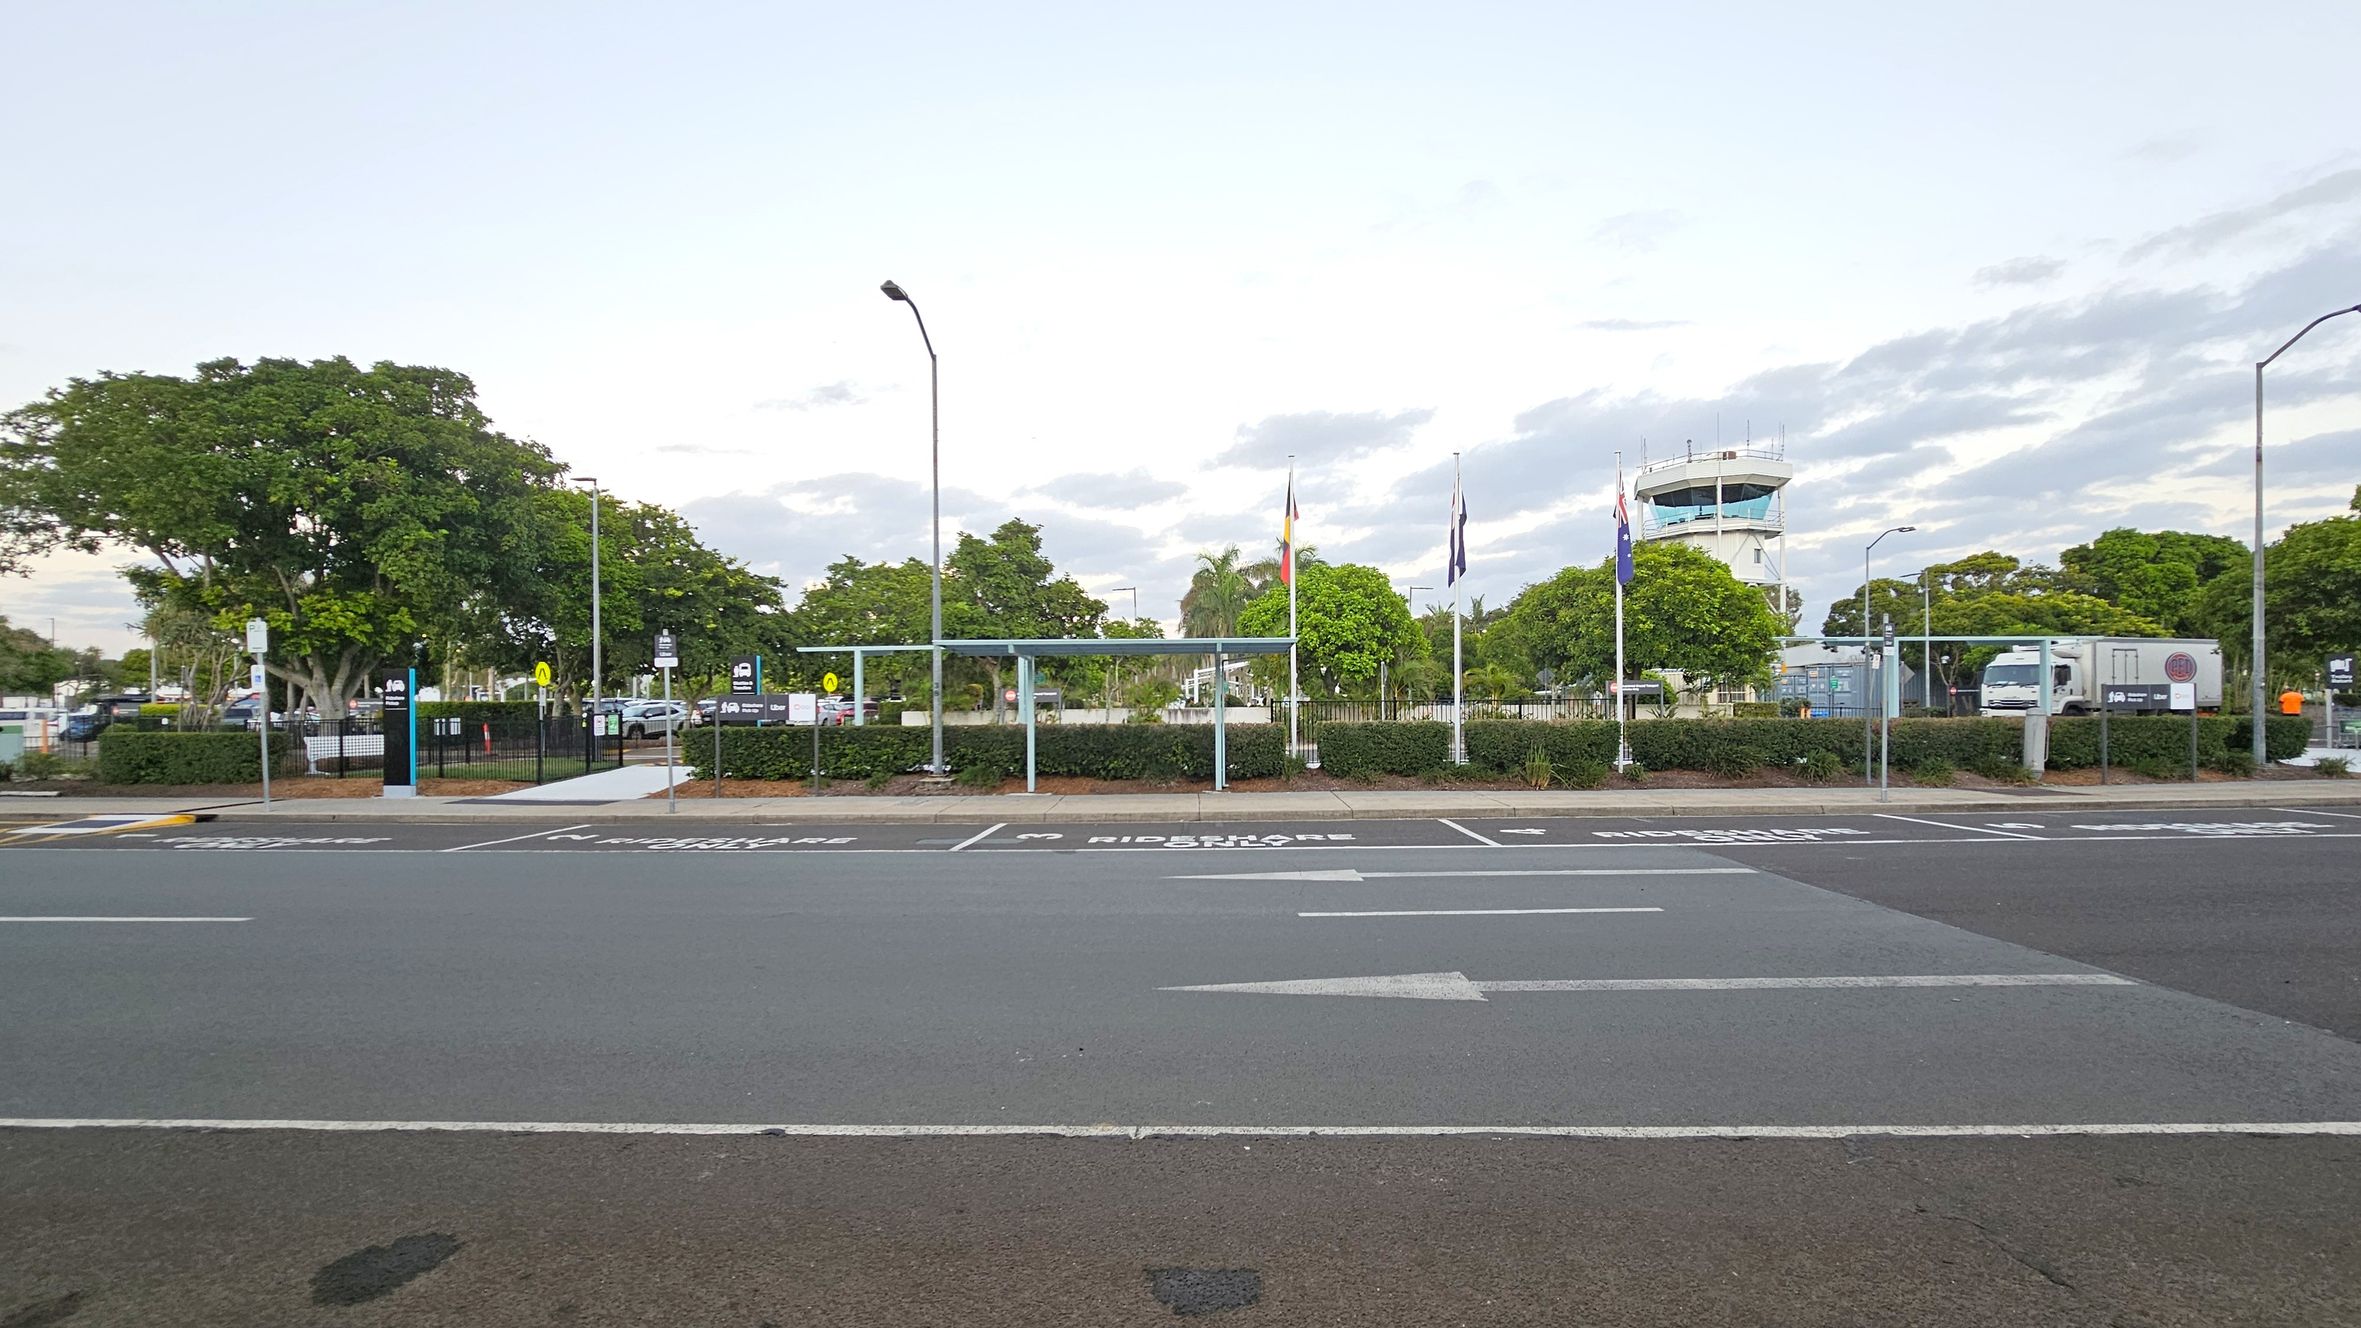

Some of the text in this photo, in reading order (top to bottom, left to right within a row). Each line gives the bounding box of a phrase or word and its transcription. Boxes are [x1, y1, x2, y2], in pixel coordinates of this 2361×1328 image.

[1591, 828, 1871, 838] RIDESHARE
[1087, 833, 1356, 843] RIDESHARE
[1692, 834, 1822, 842] ONLY
[1162, 840, 1290, 848] ONLY
